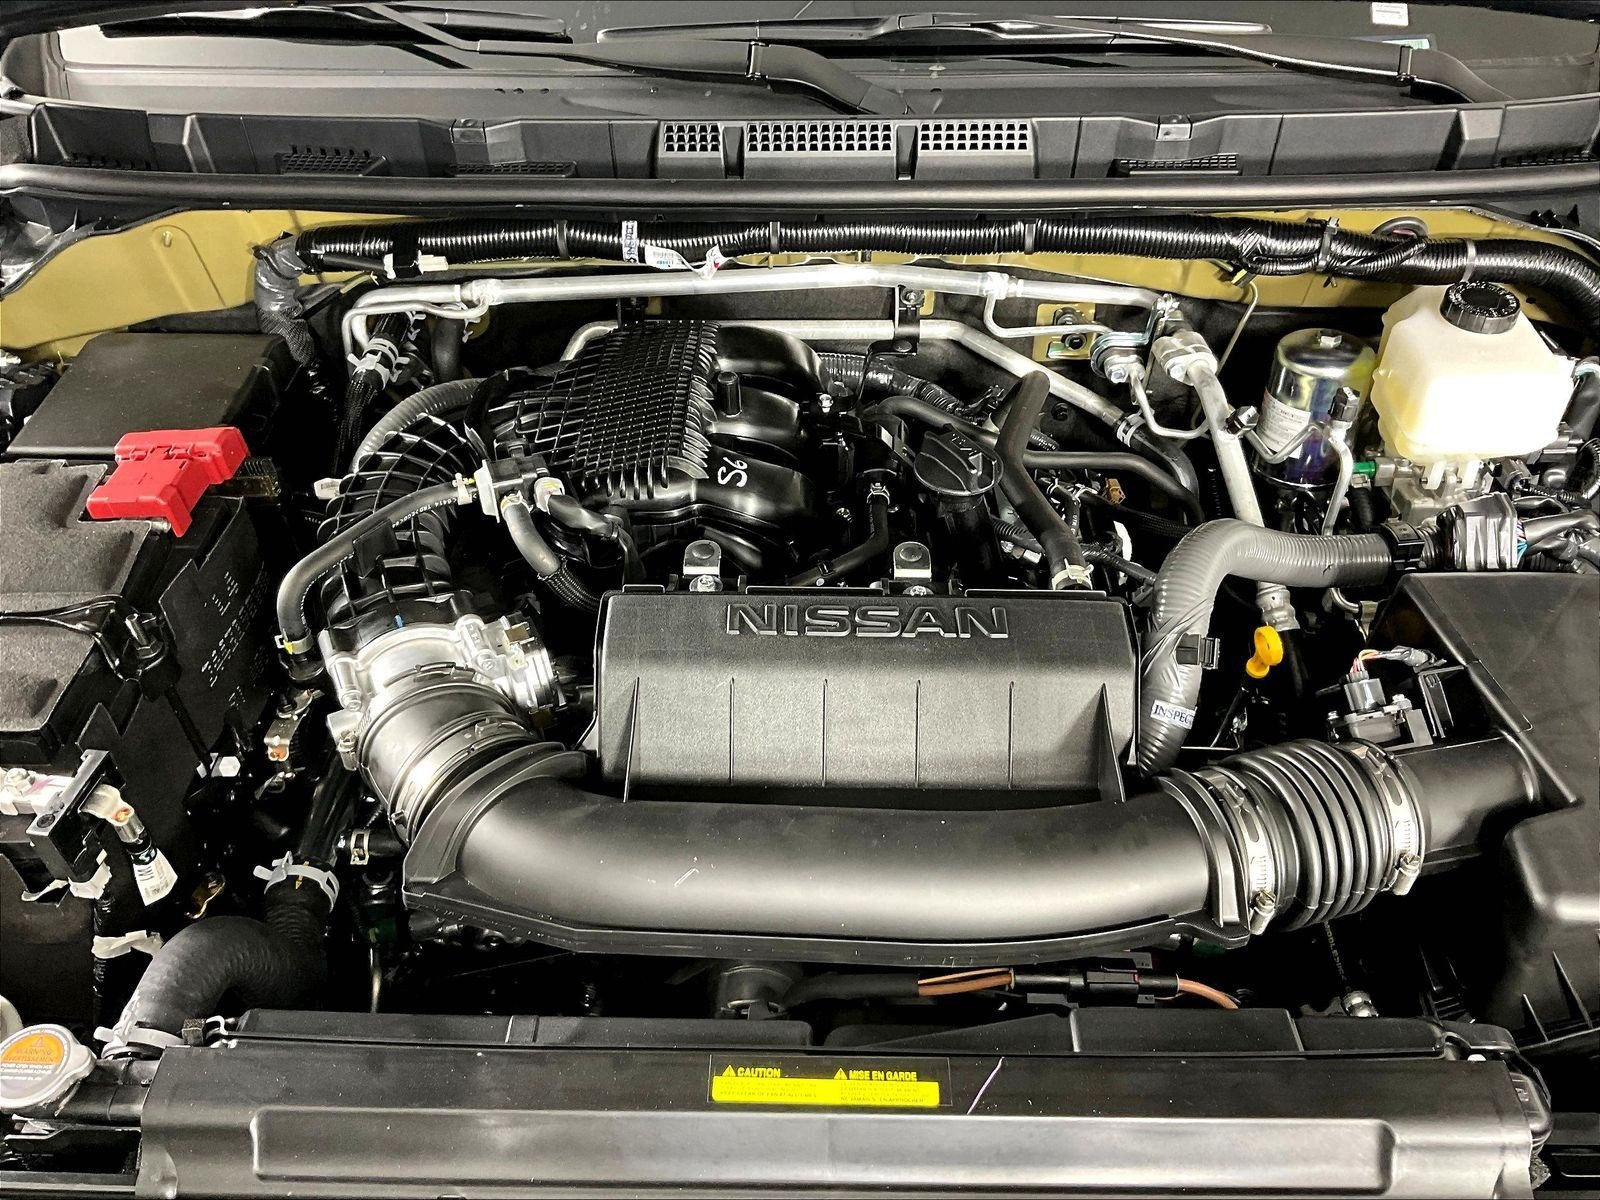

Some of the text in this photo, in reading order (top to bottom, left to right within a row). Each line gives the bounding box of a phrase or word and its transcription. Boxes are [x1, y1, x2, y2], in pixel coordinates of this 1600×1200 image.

[717, 456, 748, 488] S6
[726, 604, 1009, 639] NISSAN
[737, 1067, 781, 1078] CAUTION
[848, 1069, 918, 1082] MISE EN GARDE
